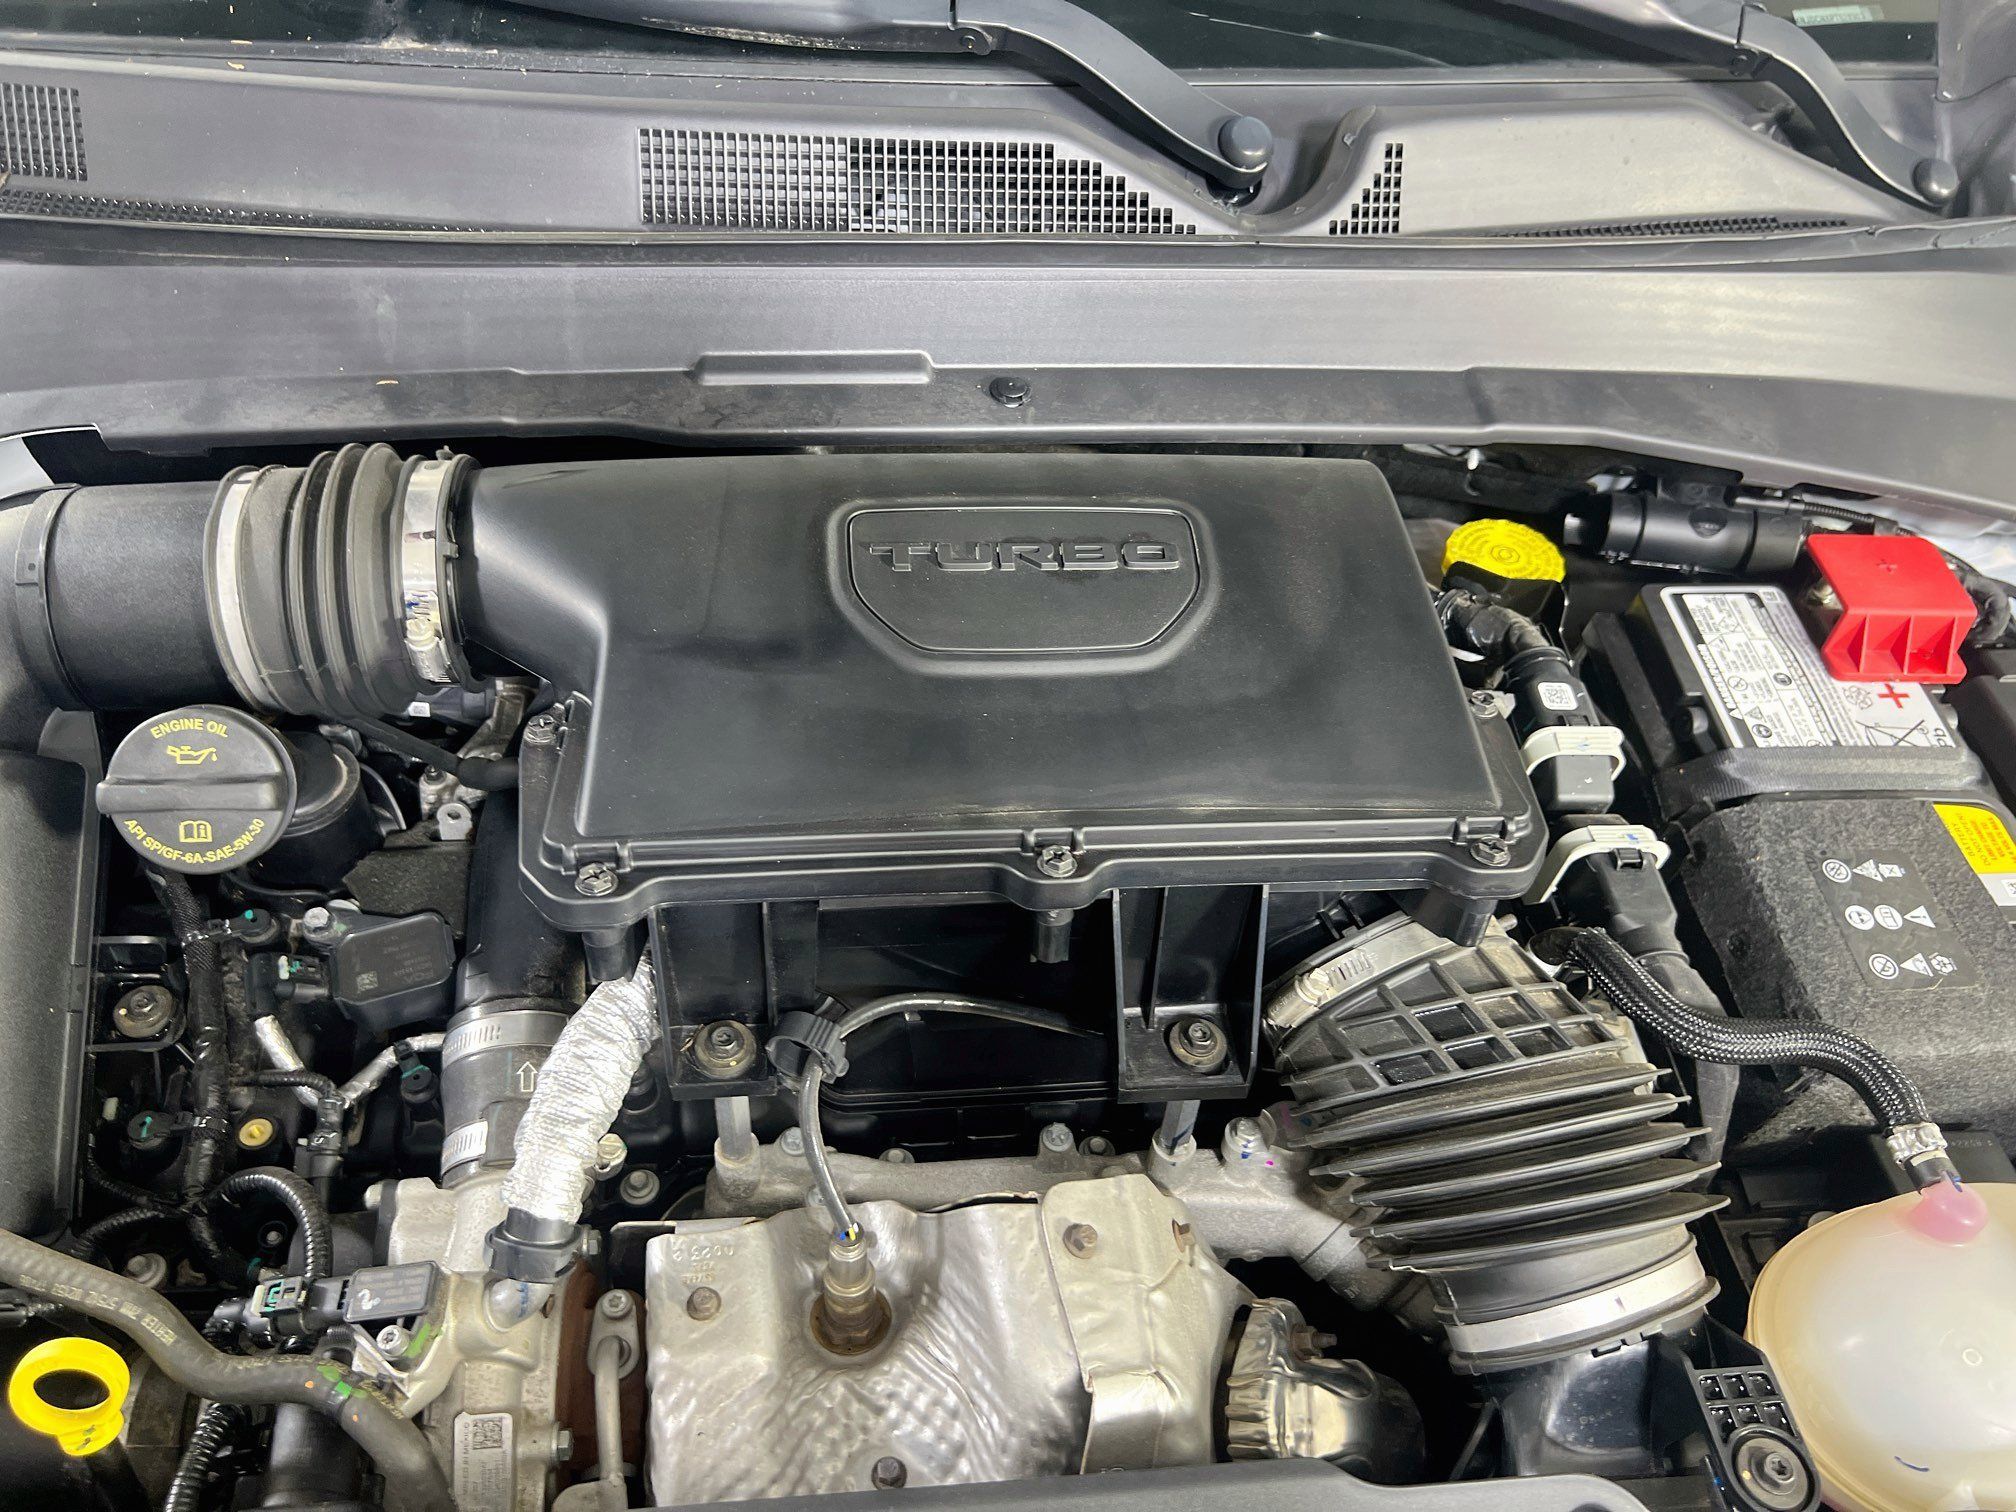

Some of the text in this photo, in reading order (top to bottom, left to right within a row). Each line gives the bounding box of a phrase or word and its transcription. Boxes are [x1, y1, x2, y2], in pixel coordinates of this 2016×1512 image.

[869, 541, 1179, 572] TURBO
[150, 718, 228, 739] ENGINE OIL
[124, 819, 147, 840] API
